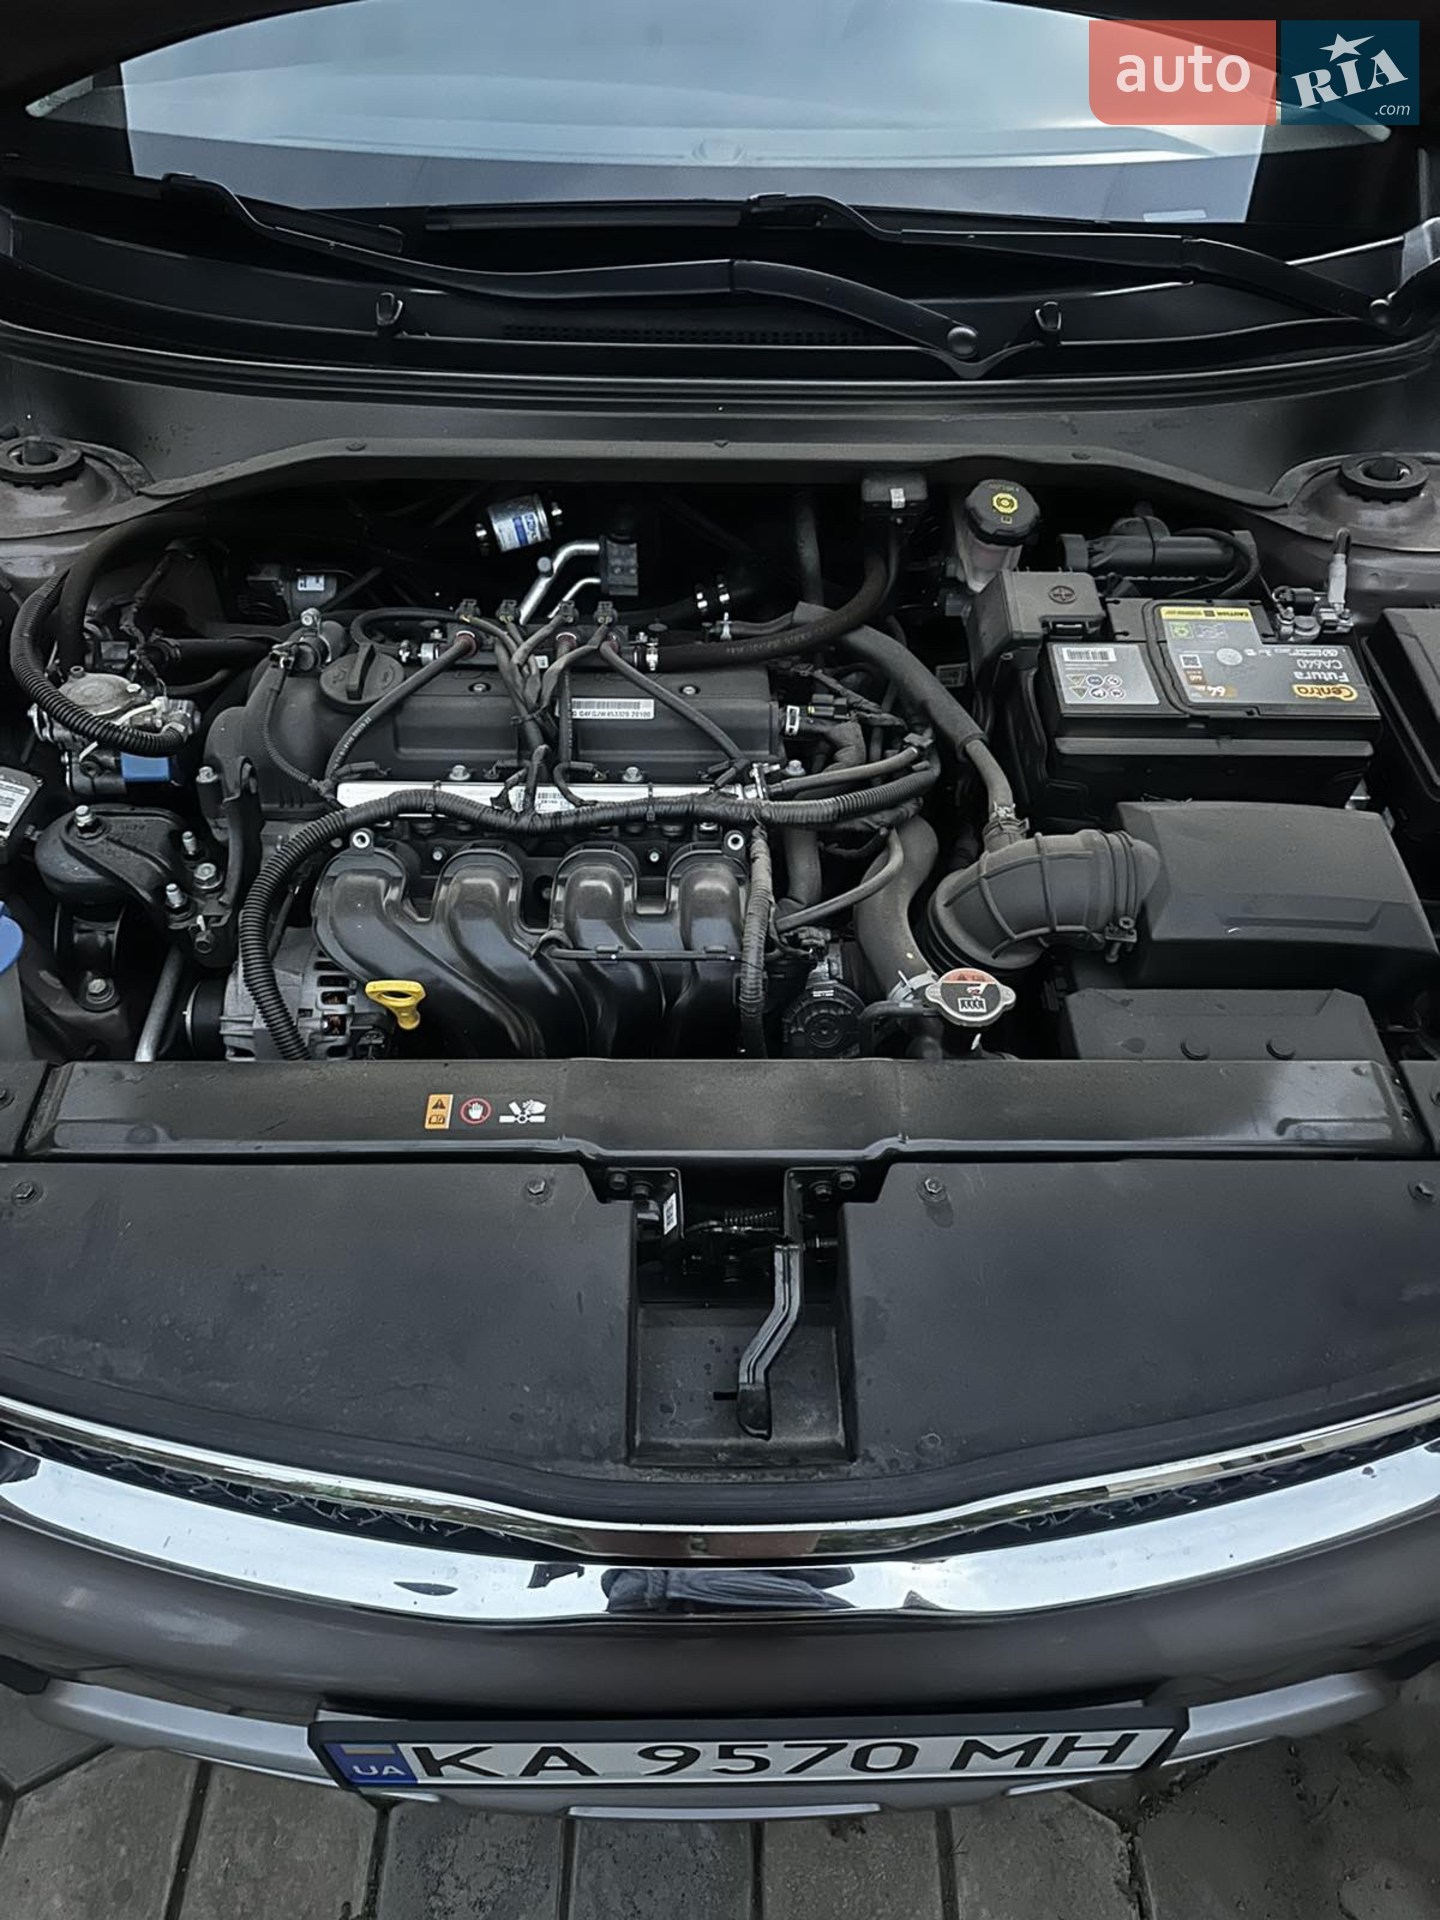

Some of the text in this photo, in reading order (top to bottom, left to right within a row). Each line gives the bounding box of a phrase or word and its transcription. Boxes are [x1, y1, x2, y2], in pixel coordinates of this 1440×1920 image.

[1297, 659, 1343, 669] CA640
[1293, 672, 1349, 682] Futura
[412, 1733, 1139, 1778] KA 9570 MH
[353, 1765, 405, 1776] UA
